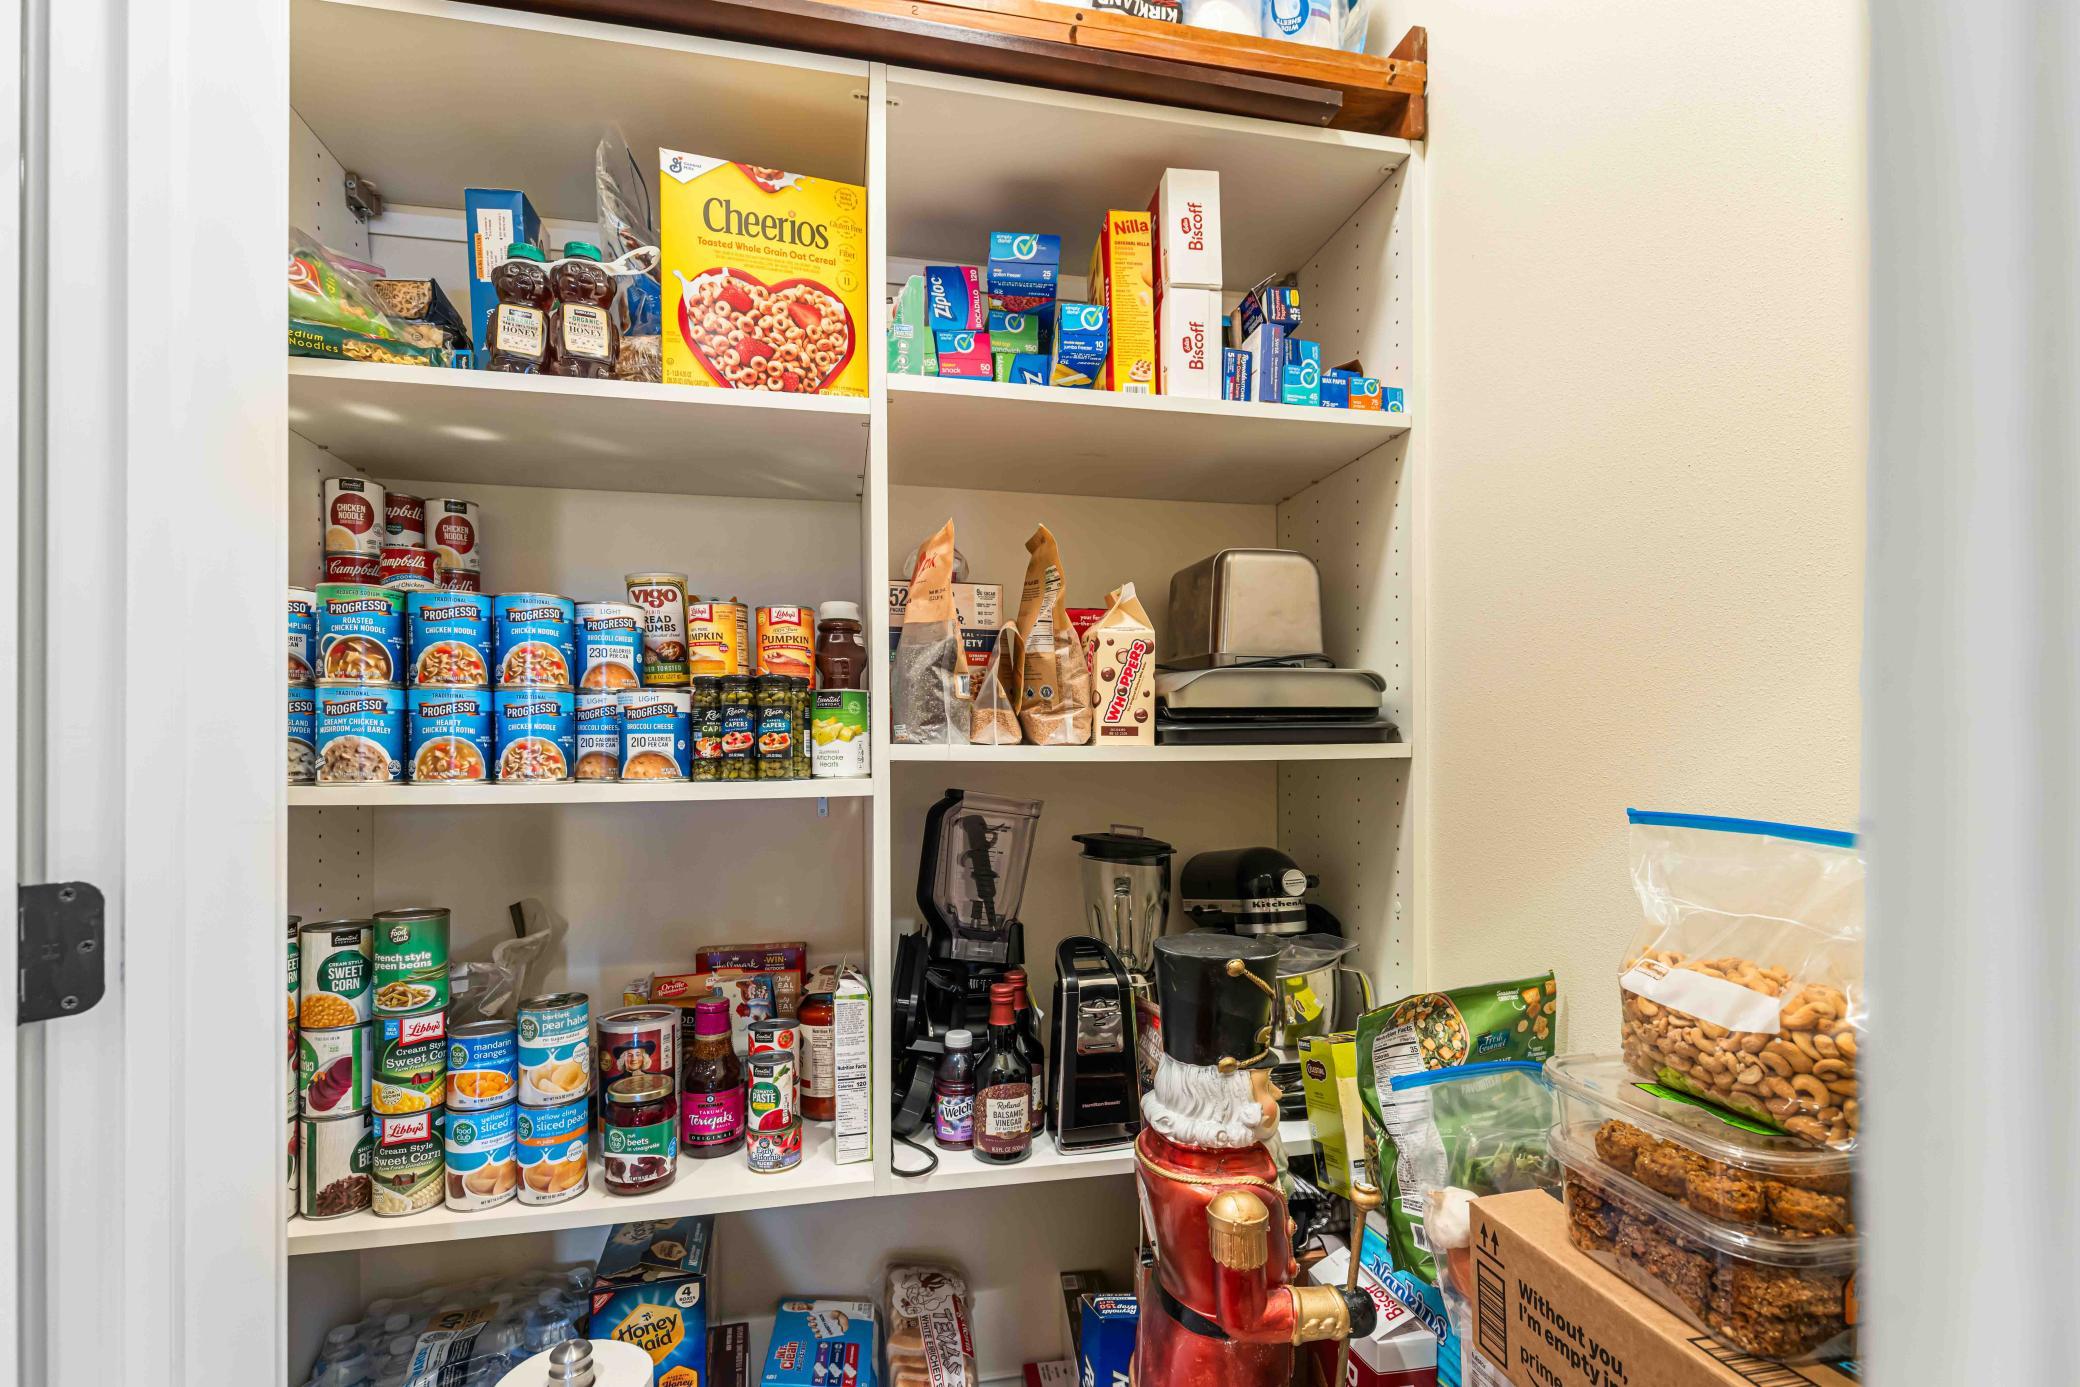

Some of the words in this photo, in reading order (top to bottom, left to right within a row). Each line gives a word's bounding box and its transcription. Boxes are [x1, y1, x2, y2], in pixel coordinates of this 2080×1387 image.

[1276, 17, 1303, 26] SHEETS
[1280, 24, 1299, 33] WIDE
[702, 197, 830, 250] Cheerios
[1114, 219, 1149, 235] Nilla
[1188, 202, 1204, 251] Biscoff
[697, 235, 734, 250] Toasted
[735, 241, 762, 254] Whole
[763, 247, 788, 260] Grain
[790, 251, 807, 262] Oat
[808, 254, 837, 267] Cereal
[969, 269, 978, 282] 120
[930, 276, 953, 319] Ziploc
[973, 289, 983, 329] BOCADILLO
[1290, 307, 1298, 321] 45
[571, 315, 600, 326] ORGANIC
[502, 325, 538, 338] HONEY
[568, 325, 602, 338] HONEY
[288, 337, 339, 353] Noodles
[1095, 340, 1104, 348] 10
[1189, 321, 1205, 371] Biscoff
[980, 363, 990, 371] 50
[337, 503, 366, 513] CHICKEN
[338, 512, 365, 521] NOODLE
[442, 524, 469, 533] CHICKEN
[443, 532, 468, 542] NOODLE
[889, 588, 909, 607] 52
[330, 600, 387, 614] PROGRESSO
[424, 606, 477, 620] PROGRESSO
[509, 607, 561, 622] PROGRESSO
[774, 608, 796, 619] Libby's
[343, 617, 374, 625] ROASTED
[587, 619, 633, 631] PROGRESSO
[331, 624, 358, 632] CHICKEN
[360, 624, 386, 634] NOODLE
[425, 626, 452, 634] CHICKEN
[453, 627, 476, 636] NOODLE
[511, 627, 537, 636] CHICKEN
[537, 628, 560, 637] NOODLE
[615, 635, 634, 643] CHEESE
[761, 634, 809, 645] PUMPKIN
[589, 647, 608, 658] 230
[1106, 640, 1147, 722] WHOPPERS
[638, 695, 660, 703] LIGHT
[326, 700, 382, 715] PROGRESSO
[422, 702, 475, 717] PROGRESSO
[506, 704, 557, 718] PROGRESSO
[626, 704, 674, 719] PROGRESSO
[349, 718, 378, 726] CHICKEN
[507, 723, 532, 731] CHICKEN
[533, 723, 557, 732] NOODLE
[319, 725, 351, 734] MUSHROOM
[367, 726, 391, 735] BARLEY
[422, 726, 448, 734] CHICKEN
[455, 727, 476, 735] ROTINI
[580, 737, 594, 748] 210
[631, 736, 647, 748] 210
[391, 927, 407, 938] food
[393, 935, 409, 944] club
[374, 953, 403, 963] French
[404, 951, 432, 961] style
[765, 956, 785, 964] WIN
[375, 962, 397, 971] green
[399, 959, 433, 970] beans
[712, 959, 760, 969] Hallmark
[328, 964, 364, 980] SWEET
[331, 977, 360, 992] CORN
[661, 981, 685, 991] Orville
[542, 1011, 570, 1020] bartlett
[406, 1020, 441, 1037] Libby's
[522, 1023, 535, 1031] food
[542, 1021, 565, 1033] pear
[1375, 1030, 1397, 1042] Nutrition
[1397, 1025, 1413, 1034] Facts
[1484, 1032, 1504, 1044] Fresh
[473, 1039, 512, 1051] mandarin
[1409, 1045, 1419, 1053] 35
[1478, 1039, 1507, 1054] Gourmet
[396, 1046, 427, 1057] Cream
[452, 1051, 464, 1059] food
[473, 1049, 507, 1060] oranges
[385, 1054, 427, 1069] Sweet
[752, 1092, 776, 1103] PASTE
[997, 1100, 1022, 1110] Roland
[481, 1113, 505, 1125] yellow
[536, 1113, 560, 1123] yellow
[561, 1108, 577, 1118] cling
[993, 1108, 1024, 1119] BALSAMIC
[480, 1118, 509, 1133] sliced
[536, 1119, 565, 1132] sliced
[567, 1111, 588, 1129] peach
[688, 1111, 735, 1130] Teriyaki
[995, 1119, 1022, 1127] VINEGAR
[388, 1122, 424, 1138] Libby's
[456, 1127, 472, 1136] food
[457, 1133, 471, 1142] club
[626, 1138, 649, 1147] beets
[379, 1147, 407, 1156] Cream
[409, 1142, 434, 1152] Style
[632, 1142, 660, 1152] vinaigrette
[756, 1146, 774, 1154] Early
[374, 1157, 408, 1167] Sweet
[410, 1149, 441, 1163] Corn
[752, 1152, 781, 1161] California
[681, 1286, 692, 1296] 4
[1368, 1253, 1448, 1347] Napkins
[617, 1314, 678, 1342] Honey
[922, 1314, 933, 1338] WHITE
[1519, 1278, 1586, 1349] Without
[1589, 1338, 1629, 1386] you,
[1519, 1302, 1542, 1337] I'm
[1544, 1328, 1600, 1386] empty
[780, 1341, 799, 1370] Clean
[1520, 1345, 1563, 1387] prime
